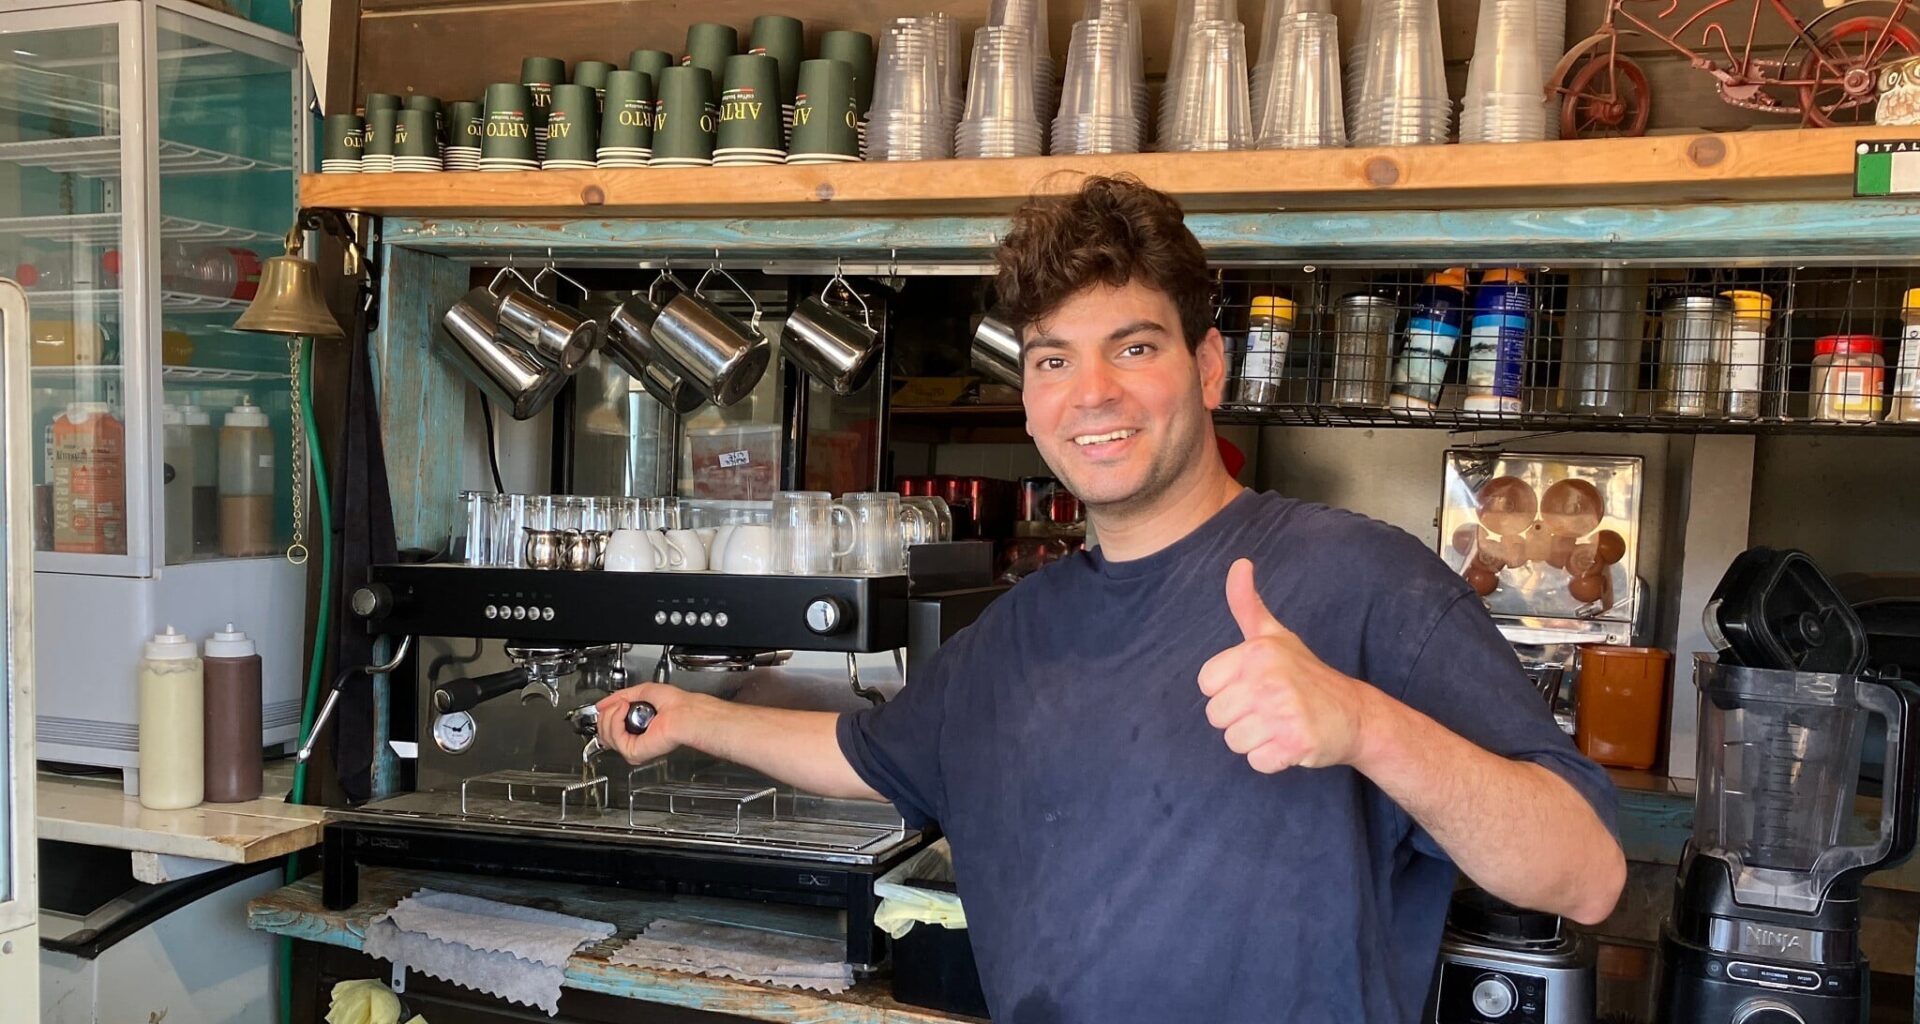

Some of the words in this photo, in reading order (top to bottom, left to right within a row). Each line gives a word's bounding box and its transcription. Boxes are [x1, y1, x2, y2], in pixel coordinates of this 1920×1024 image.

[486, 122, 529, 138] ARTO
[619, 111, 653, 128] RTO
[55, 466, 70, 530] BARISTA
[1746, 925, 1803, 953] NINJA
